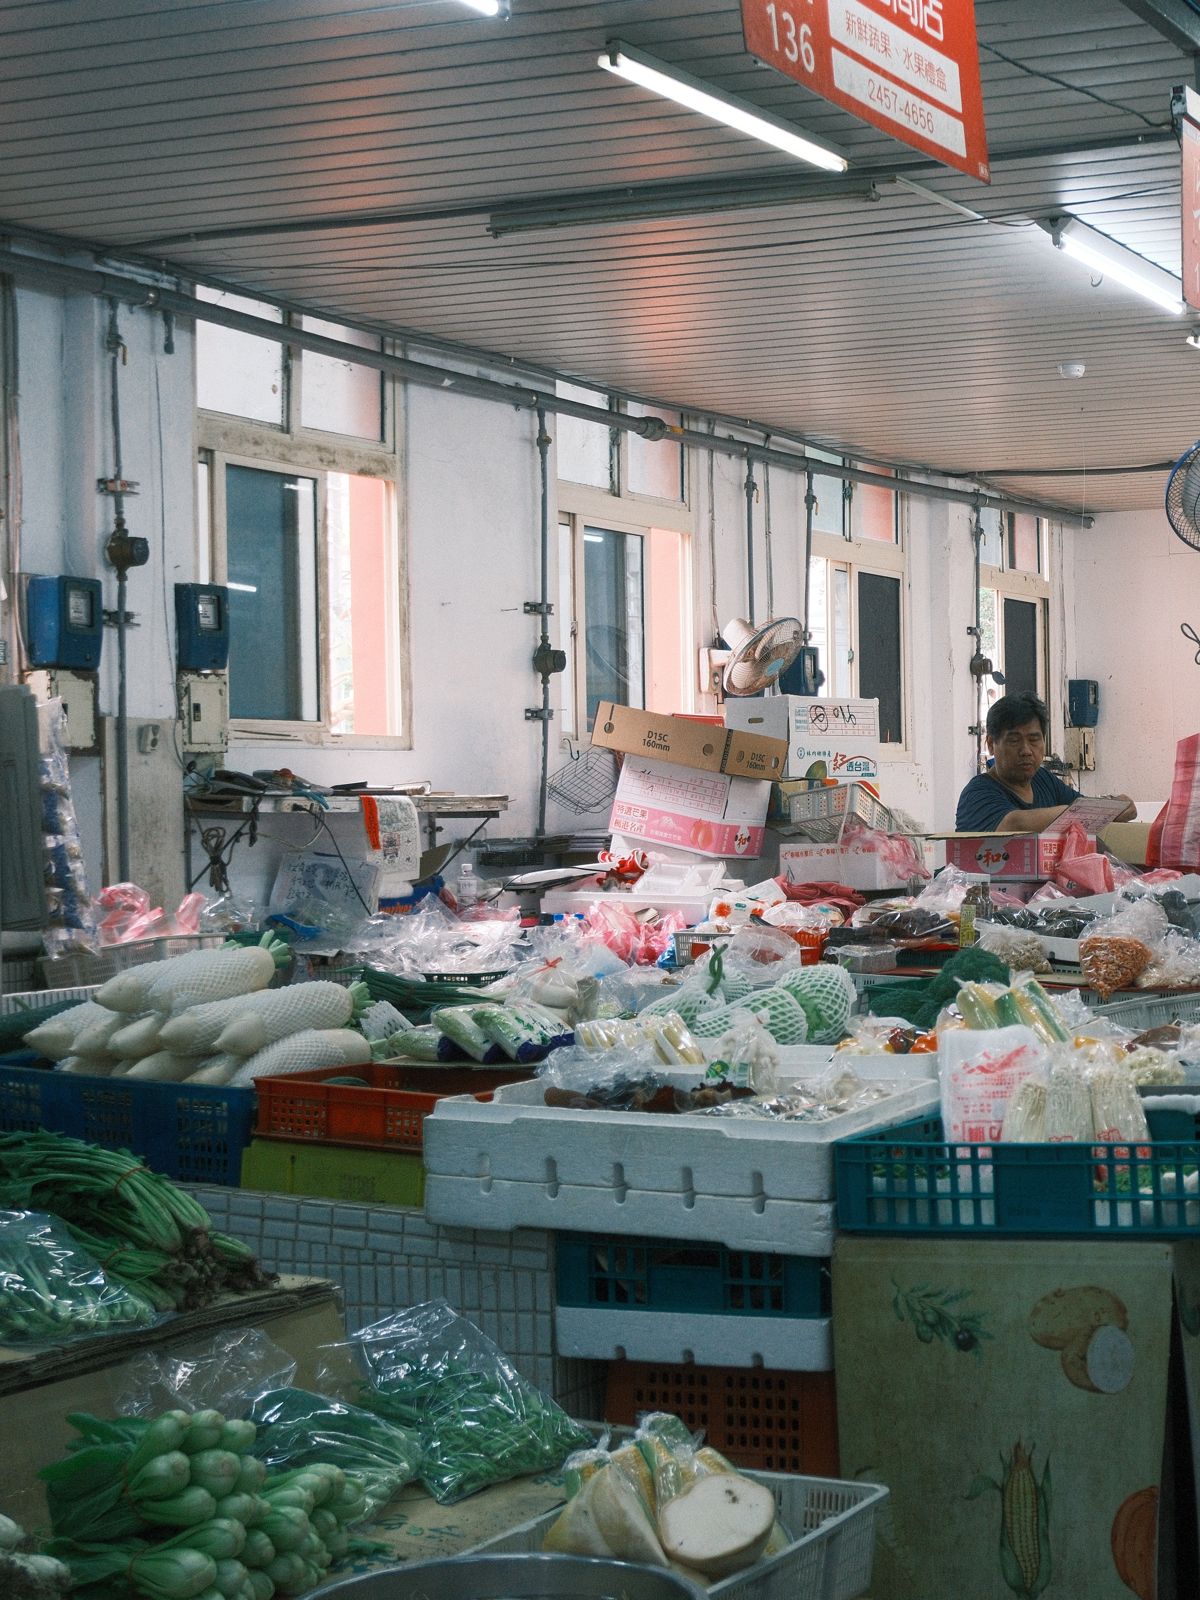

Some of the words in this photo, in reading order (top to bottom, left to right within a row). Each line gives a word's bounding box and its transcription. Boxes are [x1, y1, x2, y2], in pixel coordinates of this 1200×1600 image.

[766, 3, 815, 74] 136
[845, 10, 948, 92] 新鮮蔬果、水果禮盒
[867, 78, 934, 134] 2457-4656
[647, 730, 668, 743] D15C
[642, 738, 671, 752] 160mm
[746, 760, 766, 771] 160mm
[750, 752, 767, 763] D15C
[983, 848, 1002, 867] 和
